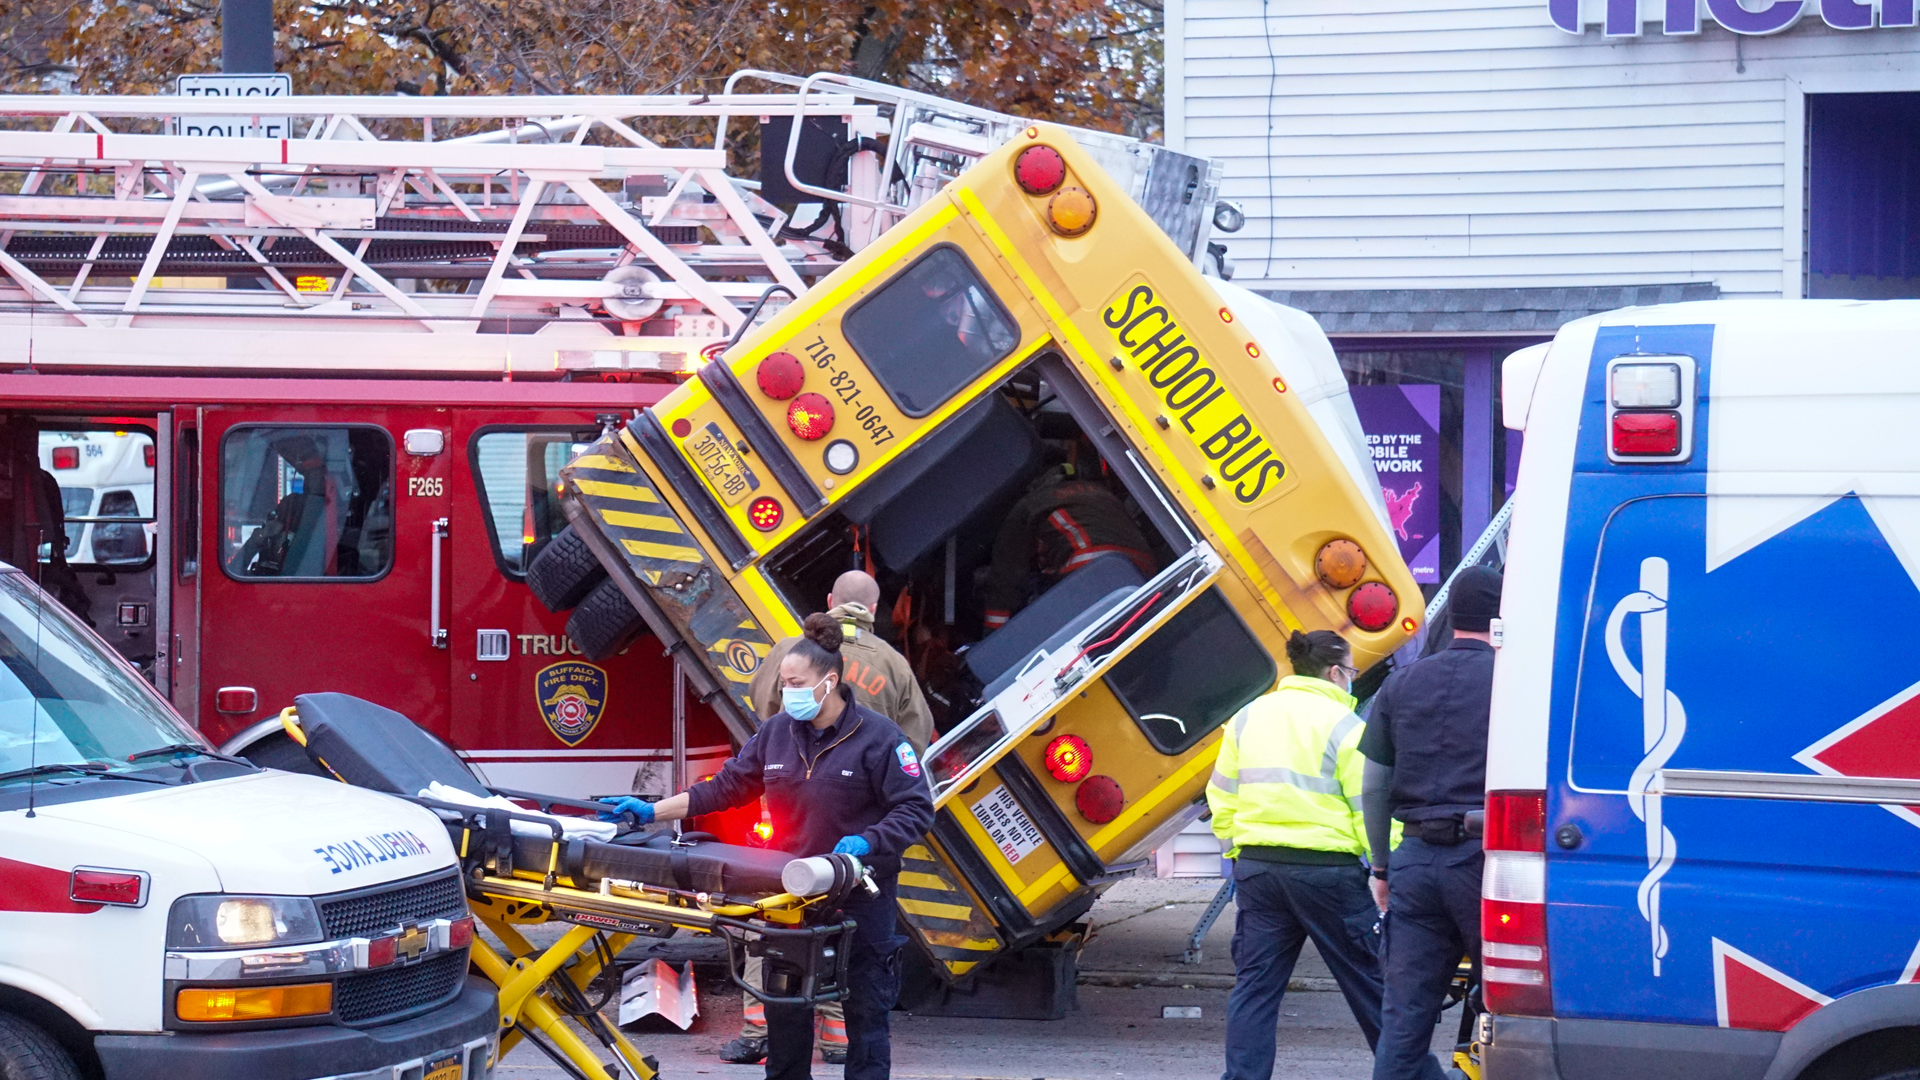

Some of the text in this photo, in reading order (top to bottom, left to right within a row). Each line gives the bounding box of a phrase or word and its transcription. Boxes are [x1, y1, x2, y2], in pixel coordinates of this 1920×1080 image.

[804, 335, 895, 446] 716-821-0647
[1103, 285, 1286, 504] SCHOOL BUS
[1365, 434, 1422, 445] ED BY THE
[85, 444, 103, 457] 564
[718, 439, 747, 475] NEW YORK
[1368, 446, 1409, 459] BILE
[1373, 459, 1423, 473] WORK
[407, 477, 444, 497] F265
[1412, 566, 1435, 575] metro
[516, 634, 583, 656] TRUC
[544, 675, 566, 688] FIRE
[548, 666, 595, 677] BUFFALO
[843, 657, 887, 696] ALO
[988, 802, 1027, 846] DOES NOT
[995, 786, 1043, 847] THIS VEHICLE
[972, 804, 1020, 862] TURN ON RED
[574, 912, 620, 926] power
